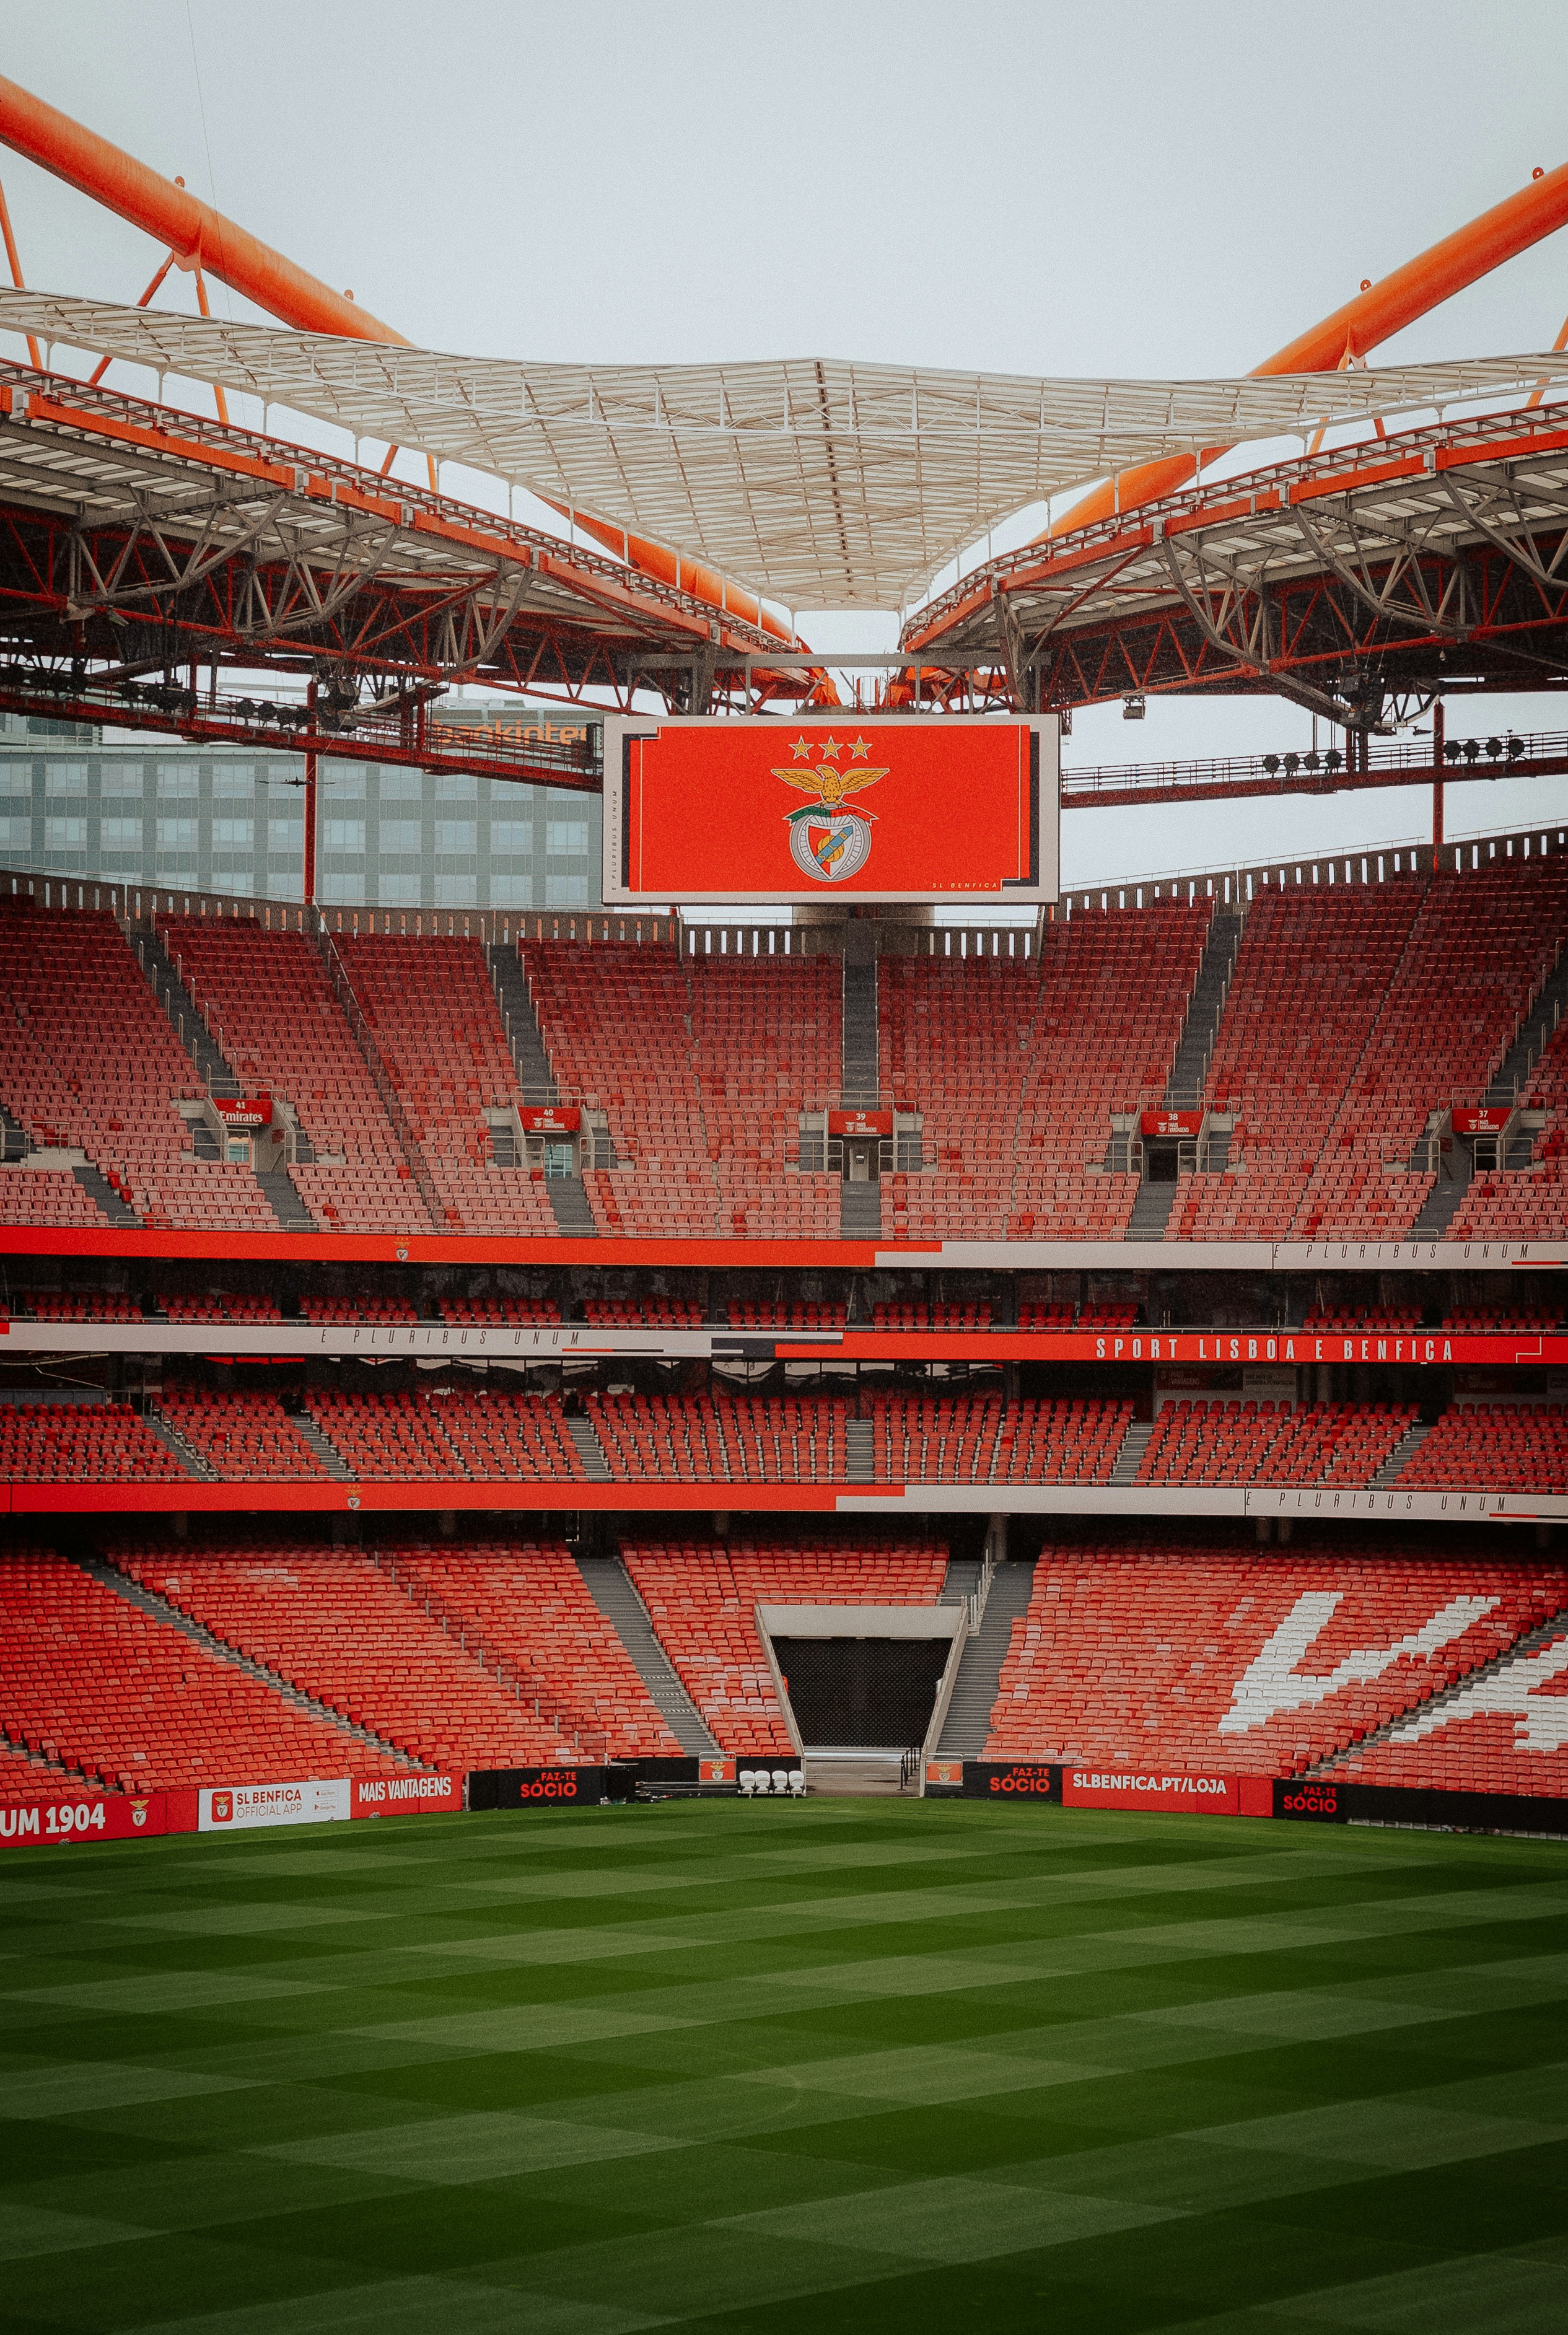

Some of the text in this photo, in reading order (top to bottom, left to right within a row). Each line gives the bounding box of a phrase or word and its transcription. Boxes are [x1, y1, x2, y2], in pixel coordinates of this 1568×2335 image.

[219, 1111, 263, 1122] Emirates
[1274, 1244, 1528, 1258] E PLURIBUS UNUM
[321, 1329, 579, 1345] E PLURIBUS UNUM
[1096, 1338, 1452, 1360] SPORT LISBOA E BENFICA
[1246, 1491, 1505, 1512] E PLURIBUS UNUM
[541, 1772, 577, 1781] FAZ-TE
[1013, 1767, 1049, 1777] FAZ-TE
[359, 1776, 452, 1802] MAIS VANTAGENS
[520, 1779, 577, 1797] SÓCIO
[989, 1774, 1050, 1792] SÓCIO
[1072, 1773, 1227, 1794] SLBENFICA.PT/LOJA
[1303, 1785, 1337, 1797] FAZ-TE
[237, 1789, 302, 1805] SL BENFICA
[1283, 1792, 1337, 1813] SÓCIO
[237, 1803, 302, 1818] OFFICIAL APP
[0, 1803, 105, 1837] UM 1904
